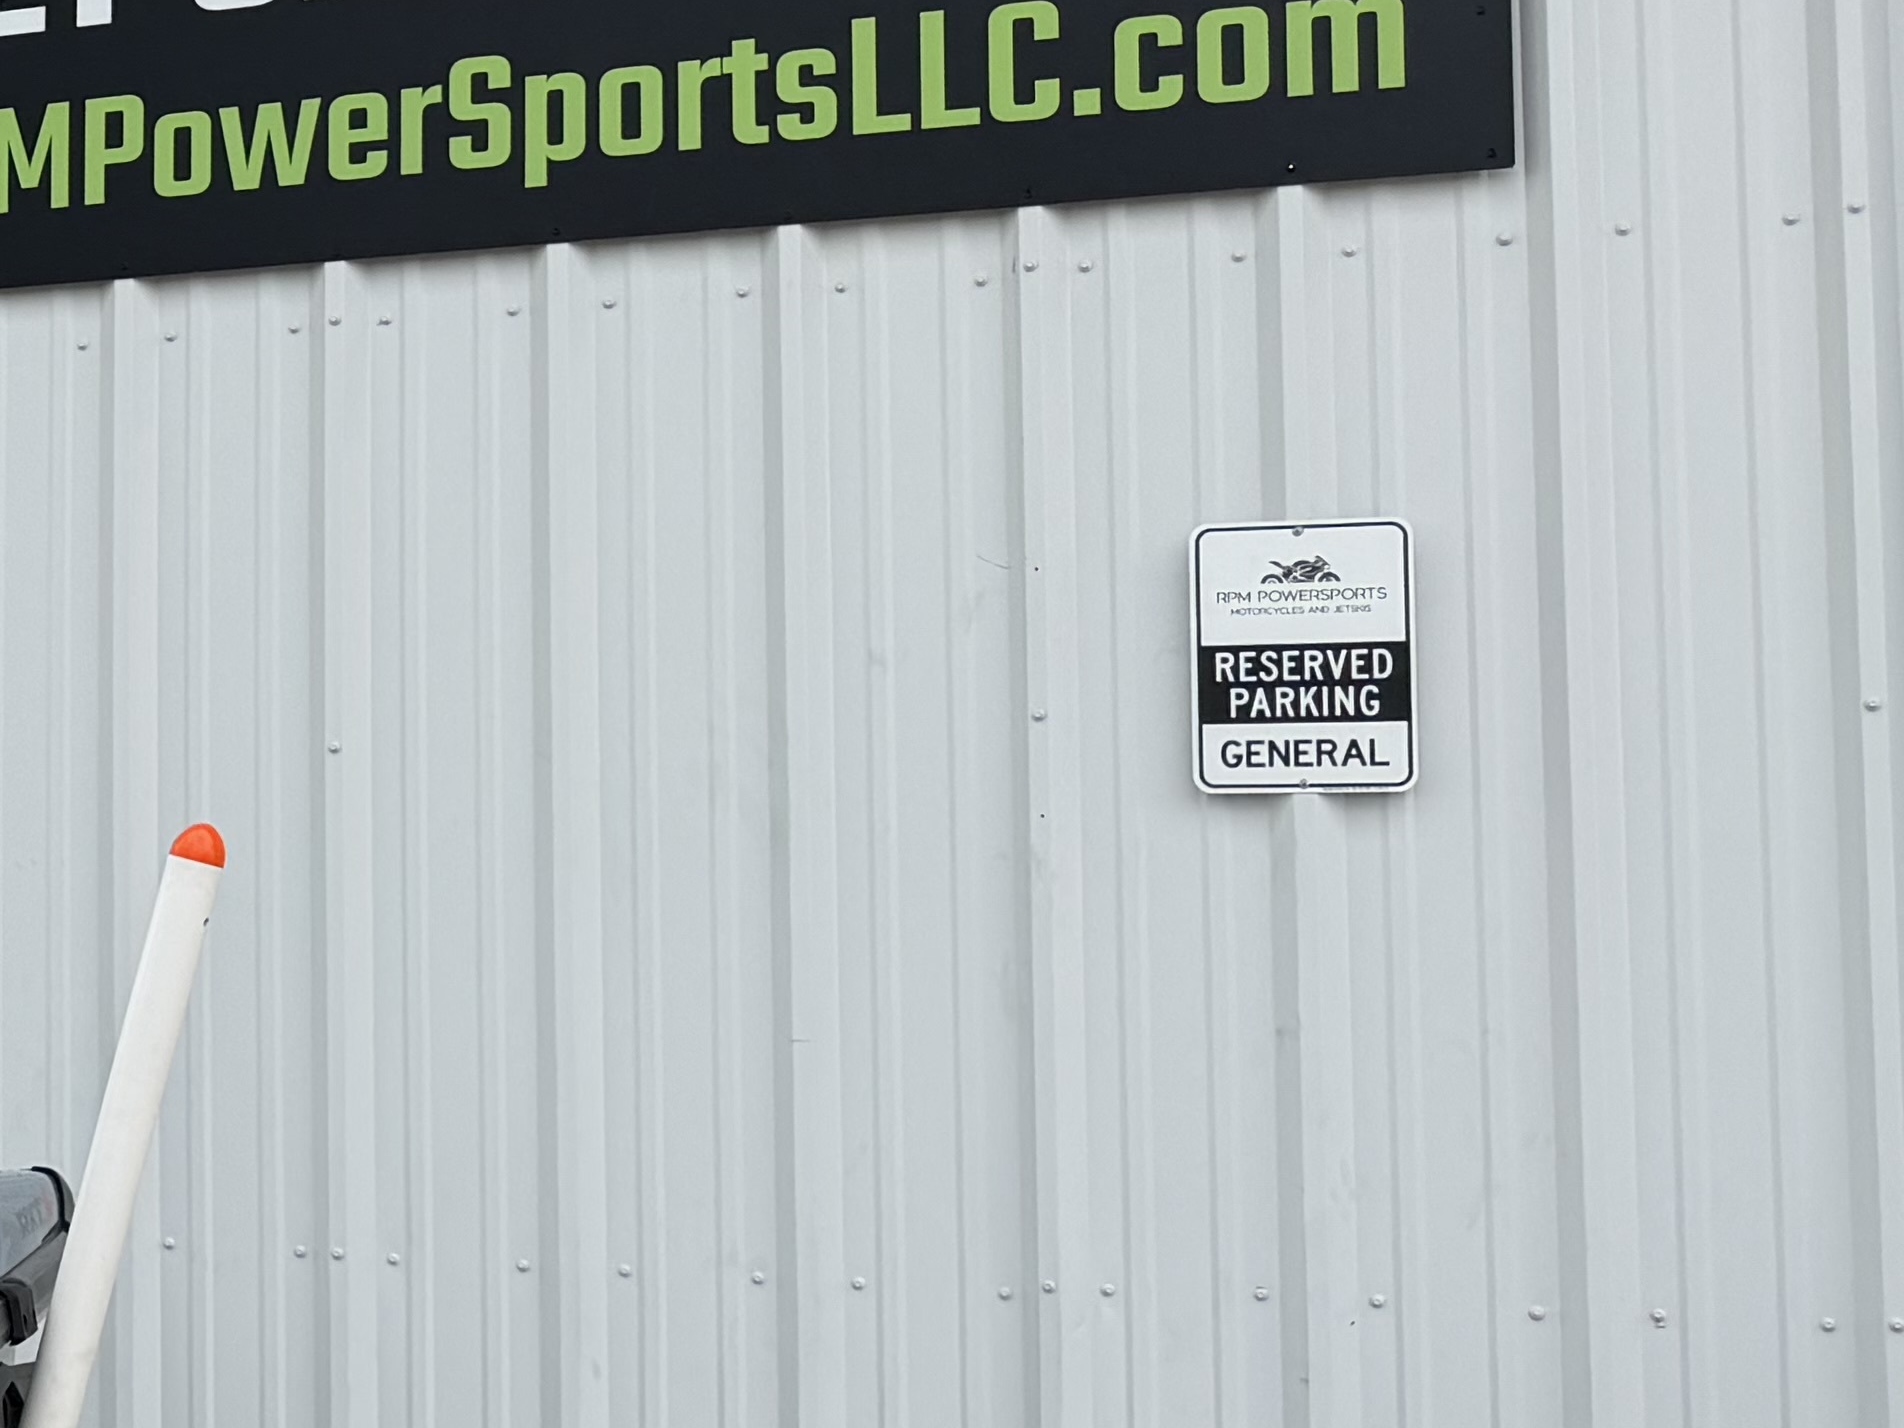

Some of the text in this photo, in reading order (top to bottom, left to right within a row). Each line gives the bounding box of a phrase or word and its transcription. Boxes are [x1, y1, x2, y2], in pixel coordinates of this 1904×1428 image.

[1216, 586, 1388, 605] RPM POWERSPORTS
[1214, 647, 1393, 683] RESERVED
[1229, 684, 1380, 719] PARKING
[1220, 738, 1390, 769] GENERAL
